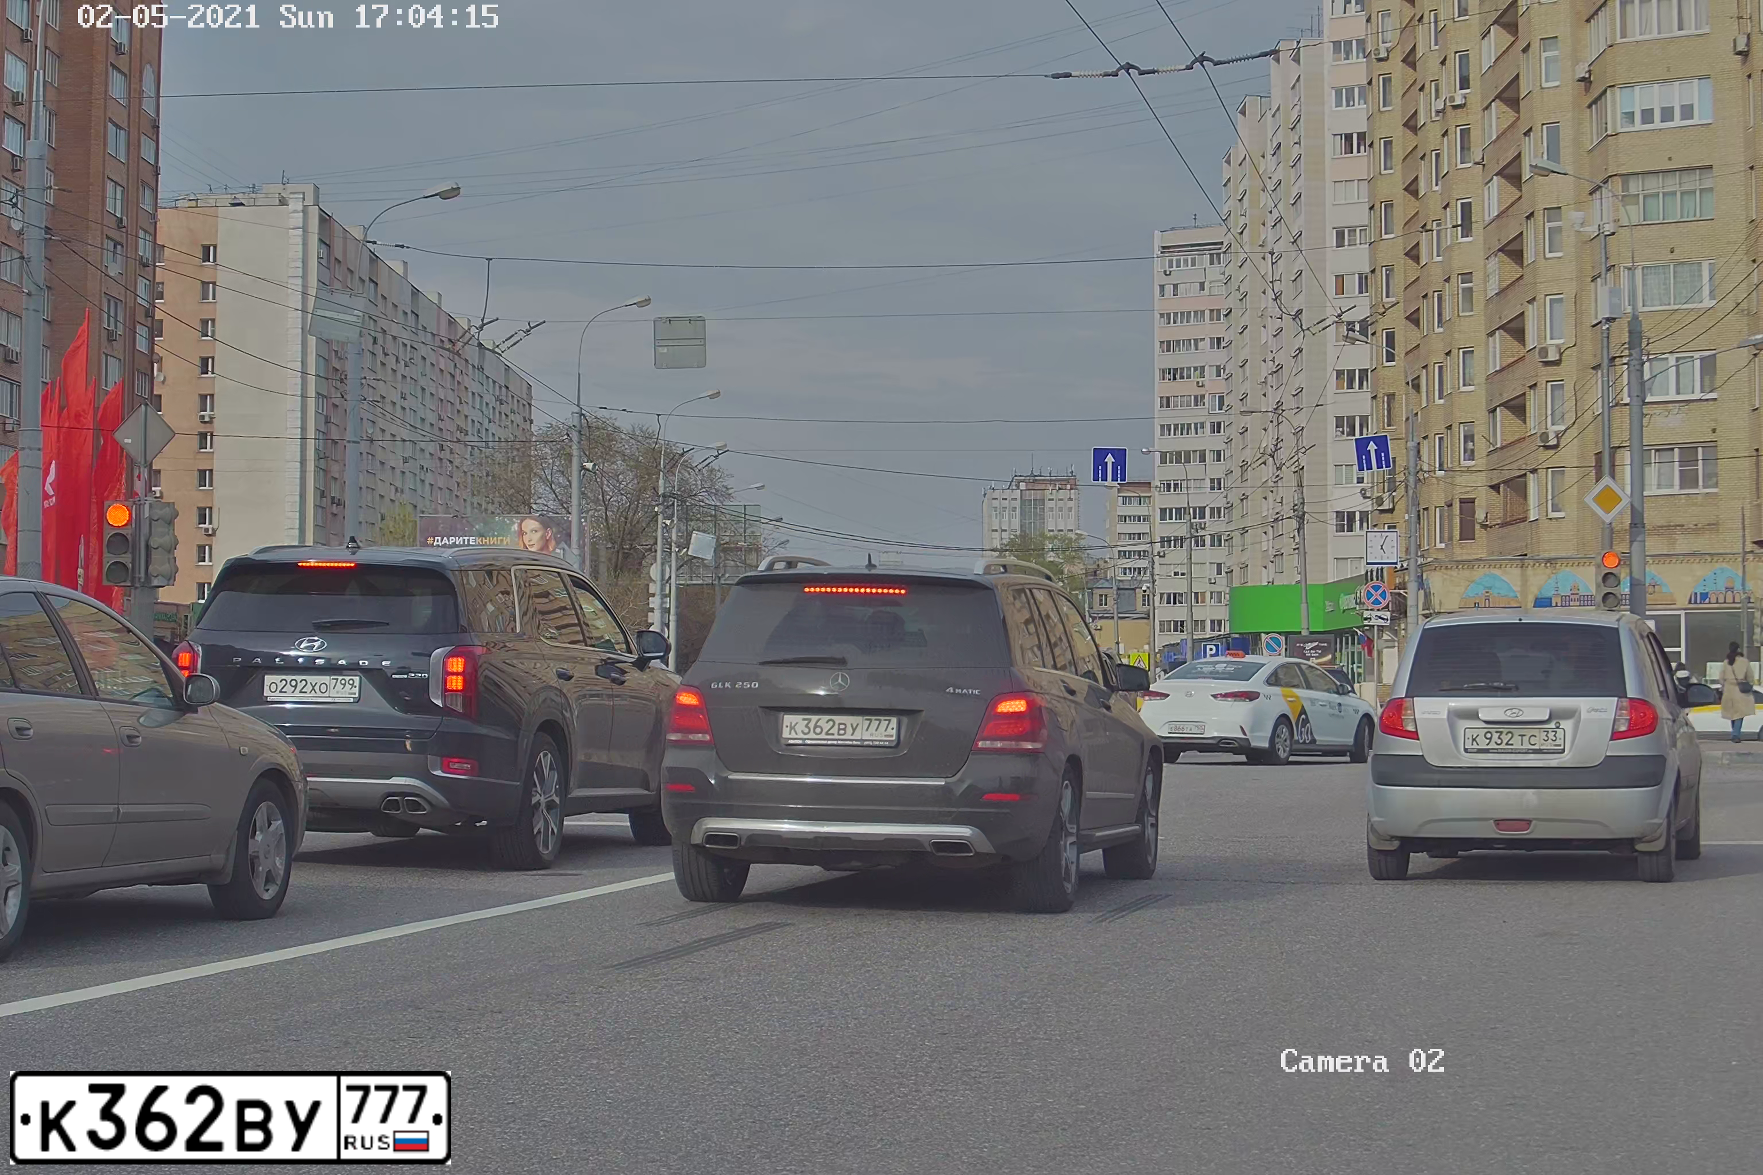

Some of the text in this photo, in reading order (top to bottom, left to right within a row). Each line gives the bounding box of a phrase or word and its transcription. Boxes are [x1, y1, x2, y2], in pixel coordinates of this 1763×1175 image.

[232, 656, 392, 667] PALISADE
[332, 677, 355, 690] 799
[710, 681, 759, 689] GLK 250
[945, 686, 981, 695] 4MATIC
[864, 718, 892, 732] 777
[1542, 730, 1558, 742] 33
